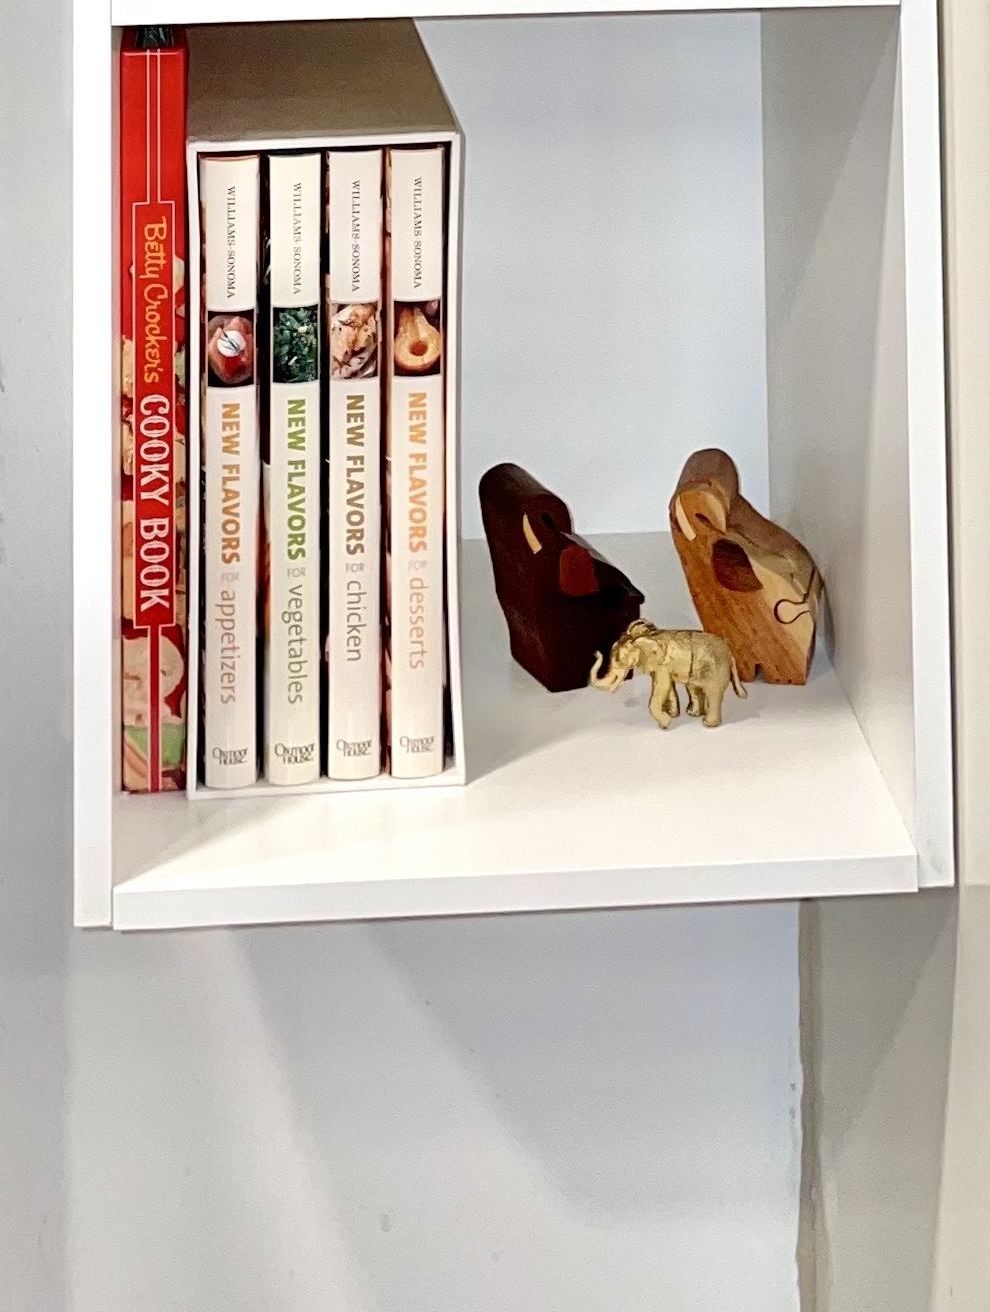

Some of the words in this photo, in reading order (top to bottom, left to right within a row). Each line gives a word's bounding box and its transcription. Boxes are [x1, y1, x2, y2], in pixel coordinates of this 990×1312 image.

[139, 215, 168, 279] Betty
[144, 283, 168, 385] Crocker's
[140, 394, 170, 507] COOKY
[221, 403, 240, 456] NEW
[286, 399, 306, 452] NEW
[346, 394, 365, 448] NEW
[408, 392, 427, 445] NEW
[221, 463, 240, 565] FLAVORS
[286, 460, 306, 561] FLAVORS
[346, 455, 365, 556] FLAVORS
[408, 451, 427, 553] FLAVORS
[140, 518, 170, 612] BOOK
[221, 573, 240, 583] FOR
[286, 567, 306, 577] FOR
[346, 563, 365, 573] FOR
[408, 561, 427, 571] FOR
[216, 589, 245, 705] appetizers
[281, 585, 308, 705] vegetables
[346, 580, 367, 663] chicken
[408, 577, 428, 670] desserts
